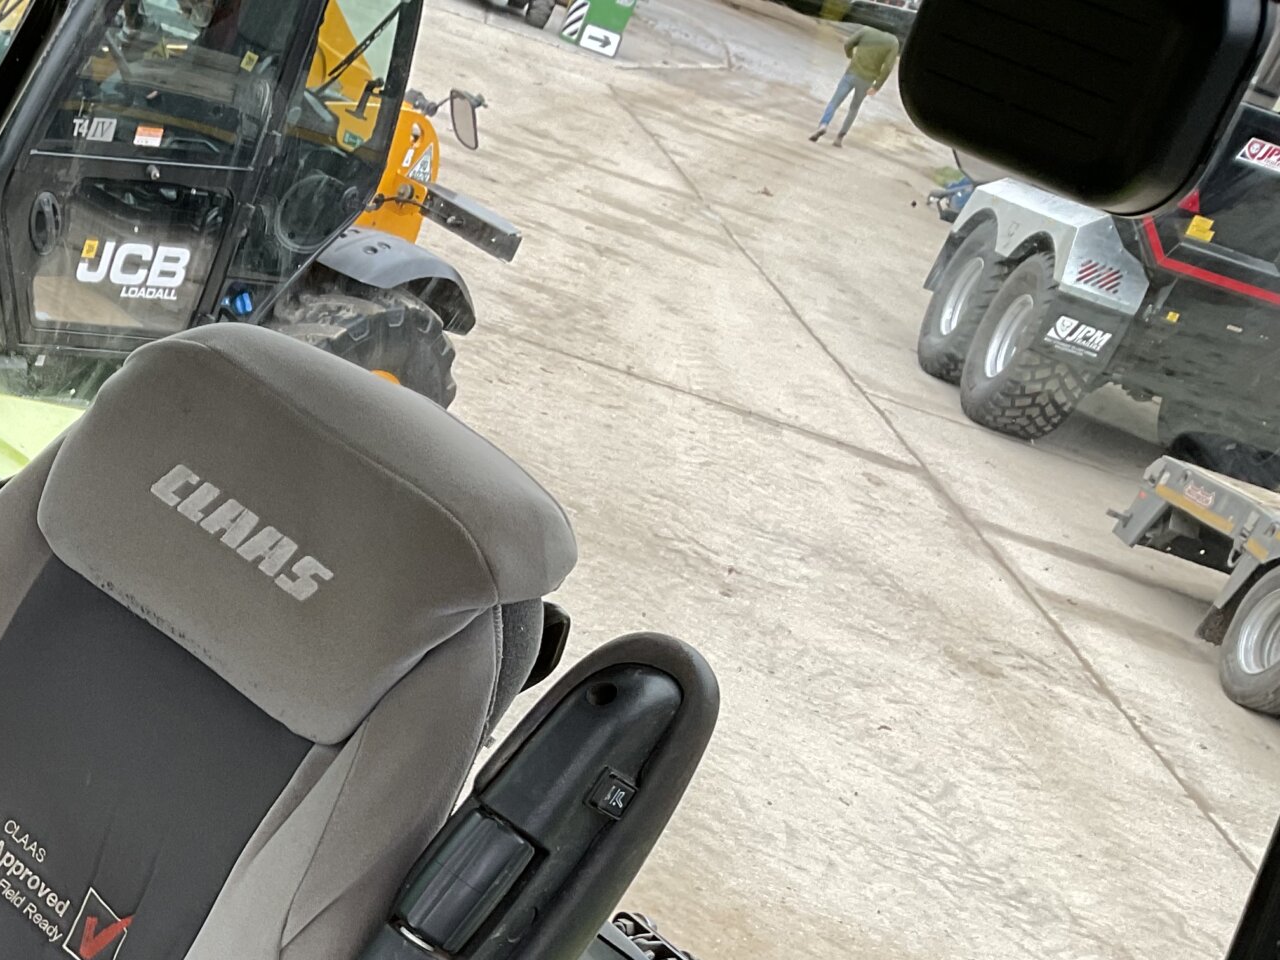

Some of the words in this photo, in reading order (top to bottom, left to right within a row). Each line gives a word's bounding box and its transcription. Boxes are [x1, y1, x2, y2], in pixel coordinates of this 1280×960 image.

[75, 240, 191, 288] JCB
[120, 286, 178, 300] LOADALL
[1065, 323, 1113, 346] JPM
[150, 463, 334, 601] CLAAS
[4, 819, 46, 863] CLAAS
[22, 902, 63, 943] Ready
